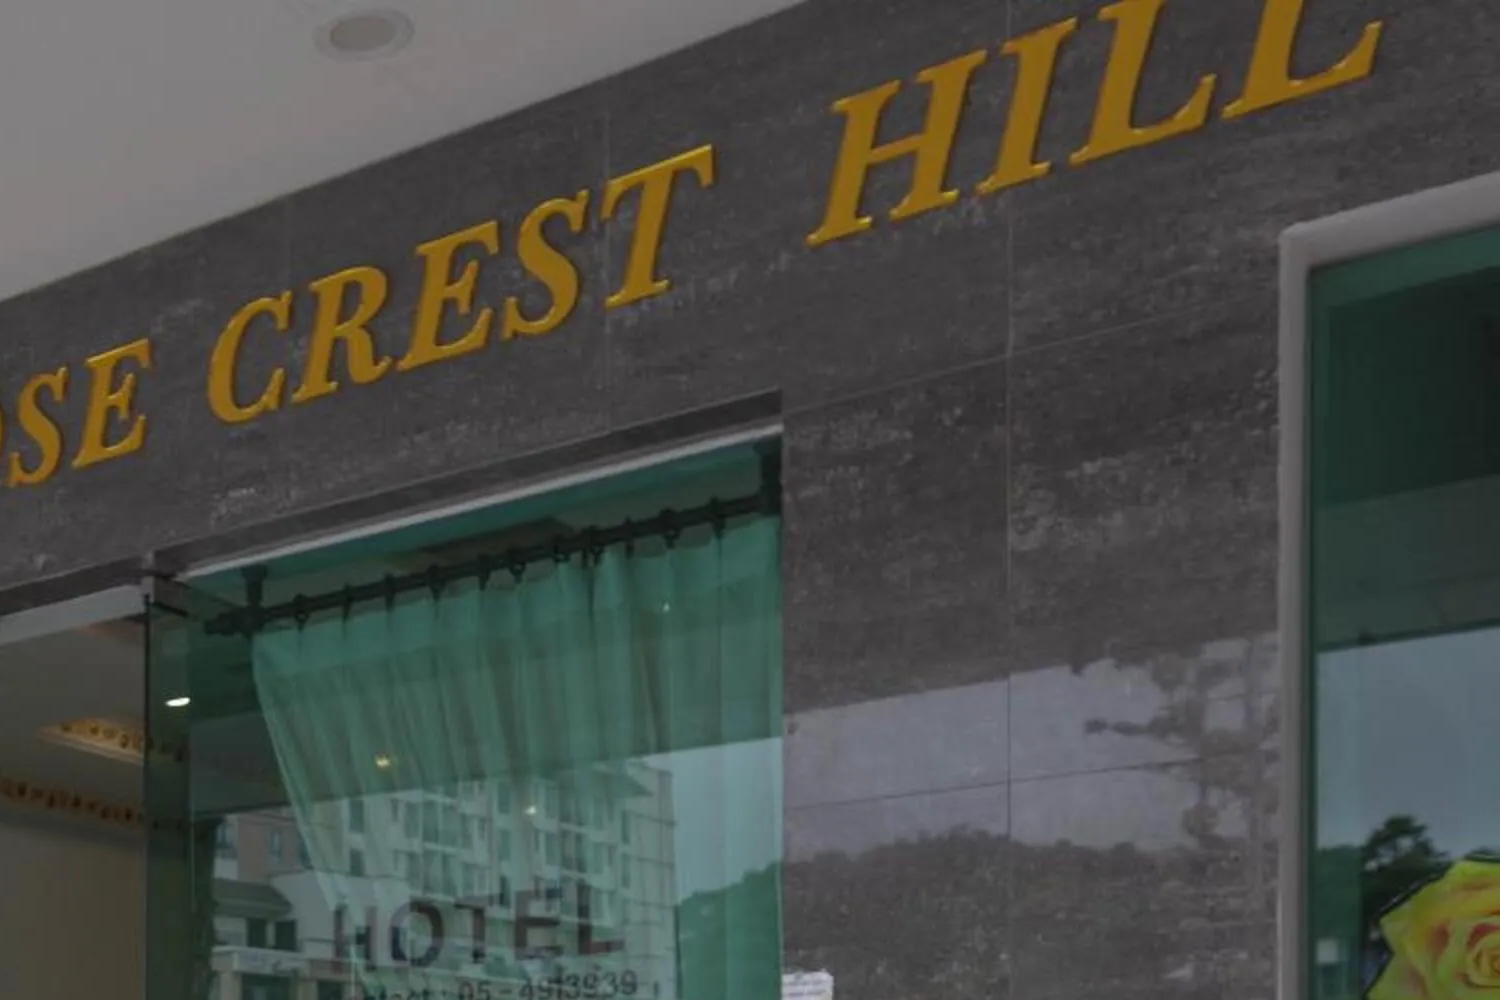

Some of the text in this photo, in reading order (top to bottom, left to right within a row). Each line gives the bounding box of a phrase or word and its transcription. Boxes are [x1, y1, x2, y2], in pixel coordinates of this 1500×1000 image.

[207, 143, 715, 424] CREST
[806, 0, 1382, 248] HILL
[333, 884, 624, 972] HOTEL
